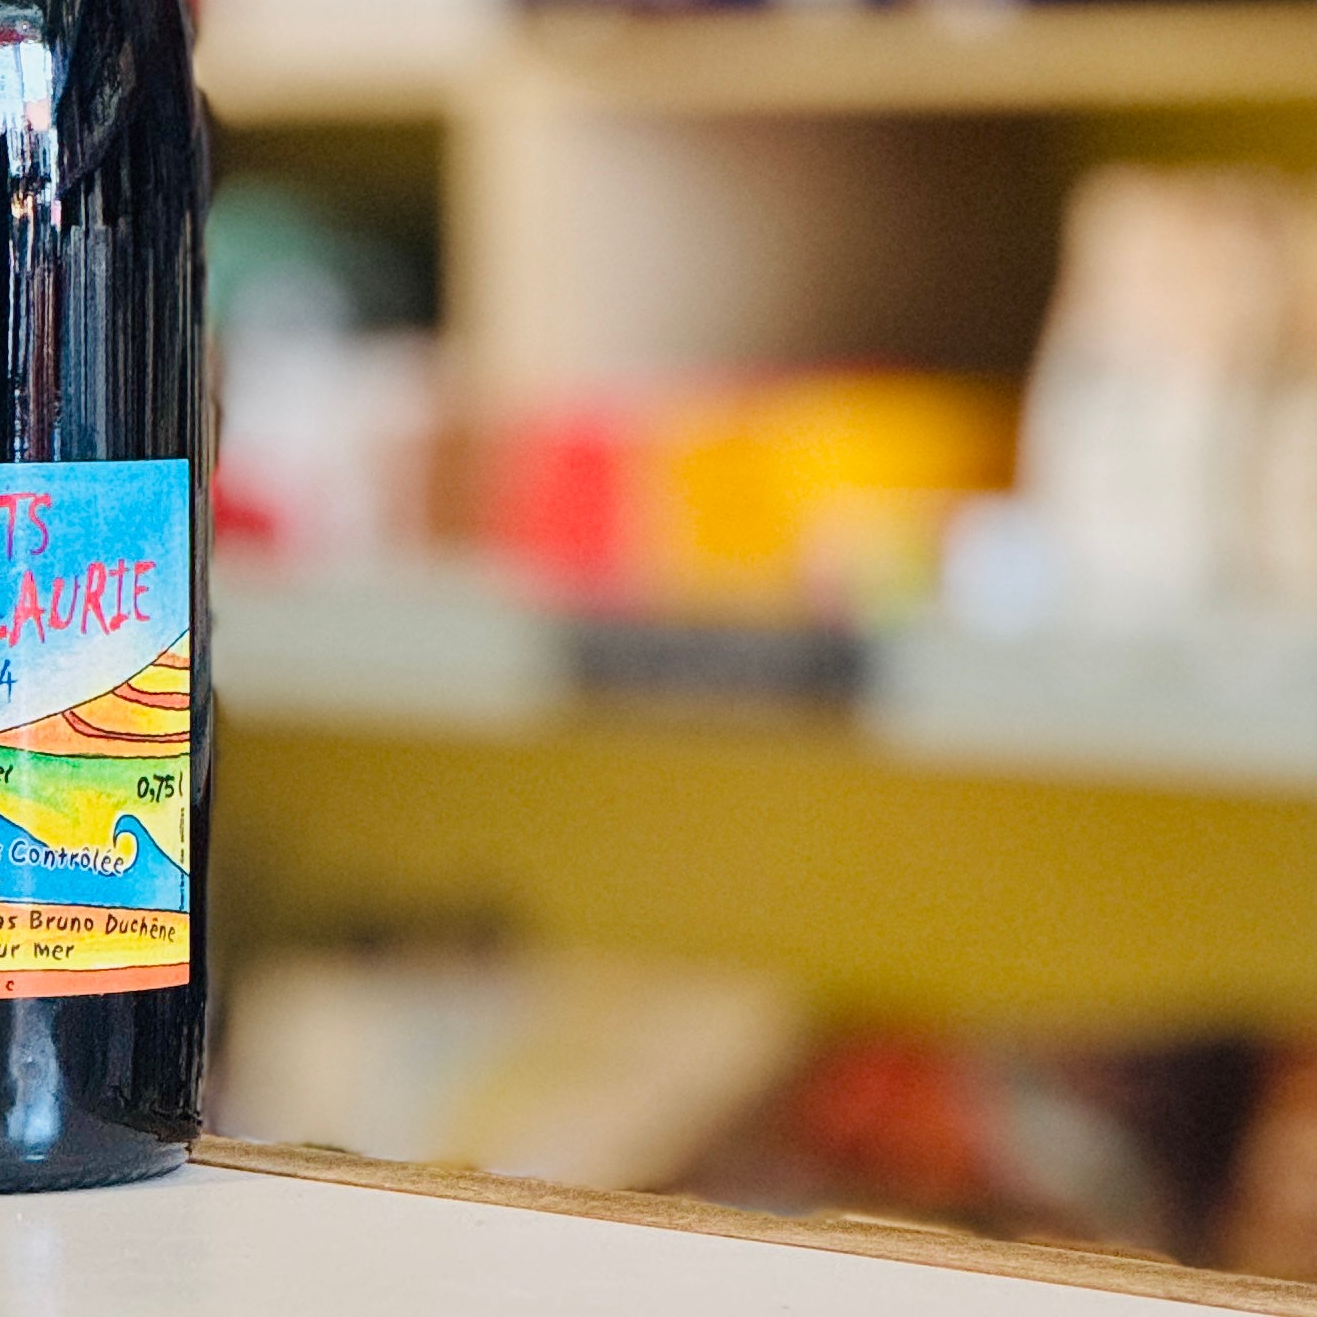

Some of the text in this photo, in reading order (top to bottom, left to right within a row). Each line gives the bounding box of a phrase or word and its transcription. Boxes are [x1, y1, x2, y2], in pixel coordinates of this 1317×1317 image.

[136, 774, 176, 803] 0,75
[11, 840, 125, 875] Contrôlée
[29, 910, 95, 932] Bruno
[105, 912, 177, 944] Duchêne
[33, 941, 75, 961] mer
